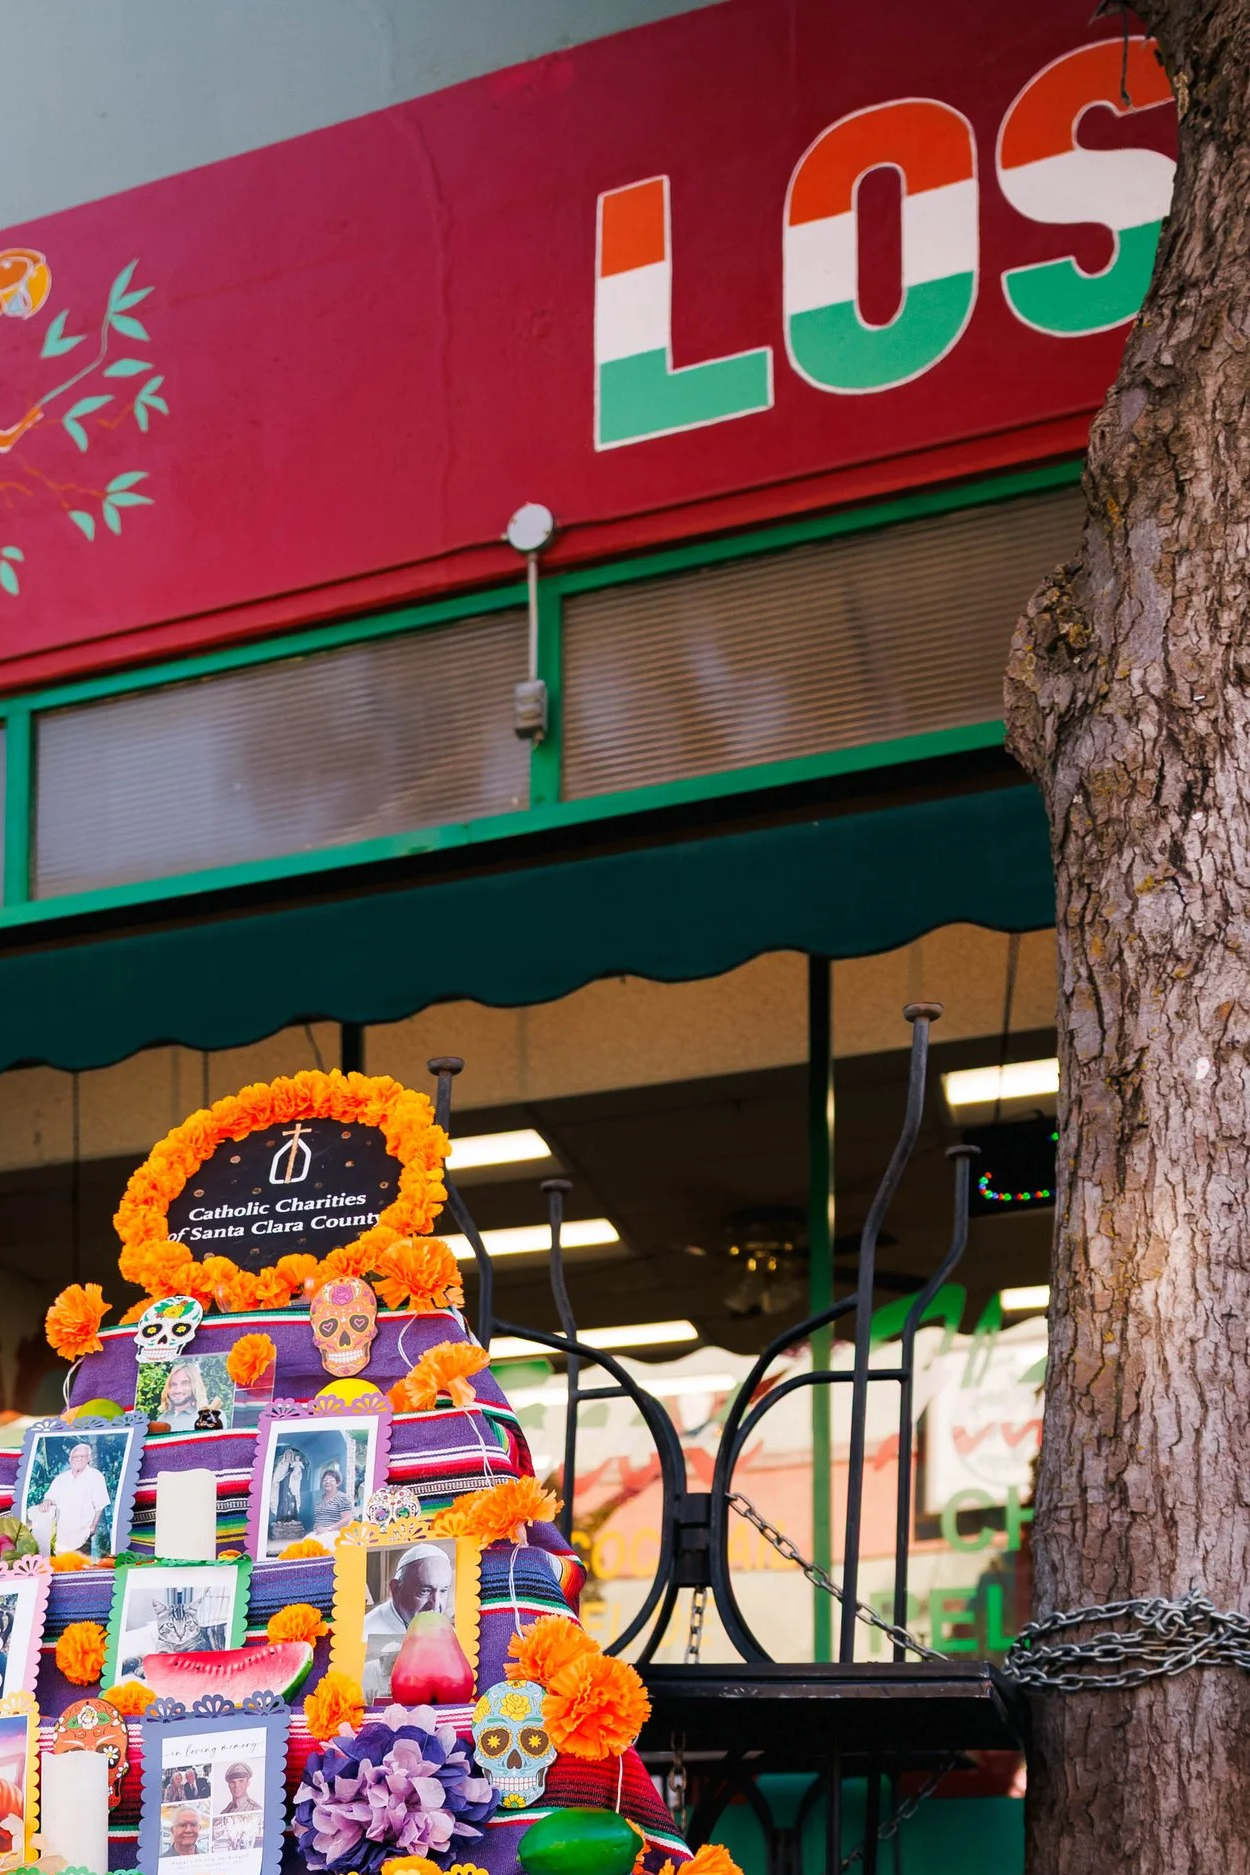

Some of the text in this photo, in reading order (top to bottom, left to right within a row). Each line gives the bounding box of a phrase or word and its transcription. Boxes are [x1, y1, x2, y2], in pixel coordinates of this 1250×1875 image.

[594, 35, 1177, 451] LOS
[188, 1192, 367, 1222] Catholic Charities
[190, 1224, 245, 1241] Santa
[251, 1219, 304, 1235] Clara
[310, 1211, 382, 1231] County
[186, 1744, 217, 1758] loving
[221, 1741, 259, 1754] memory
